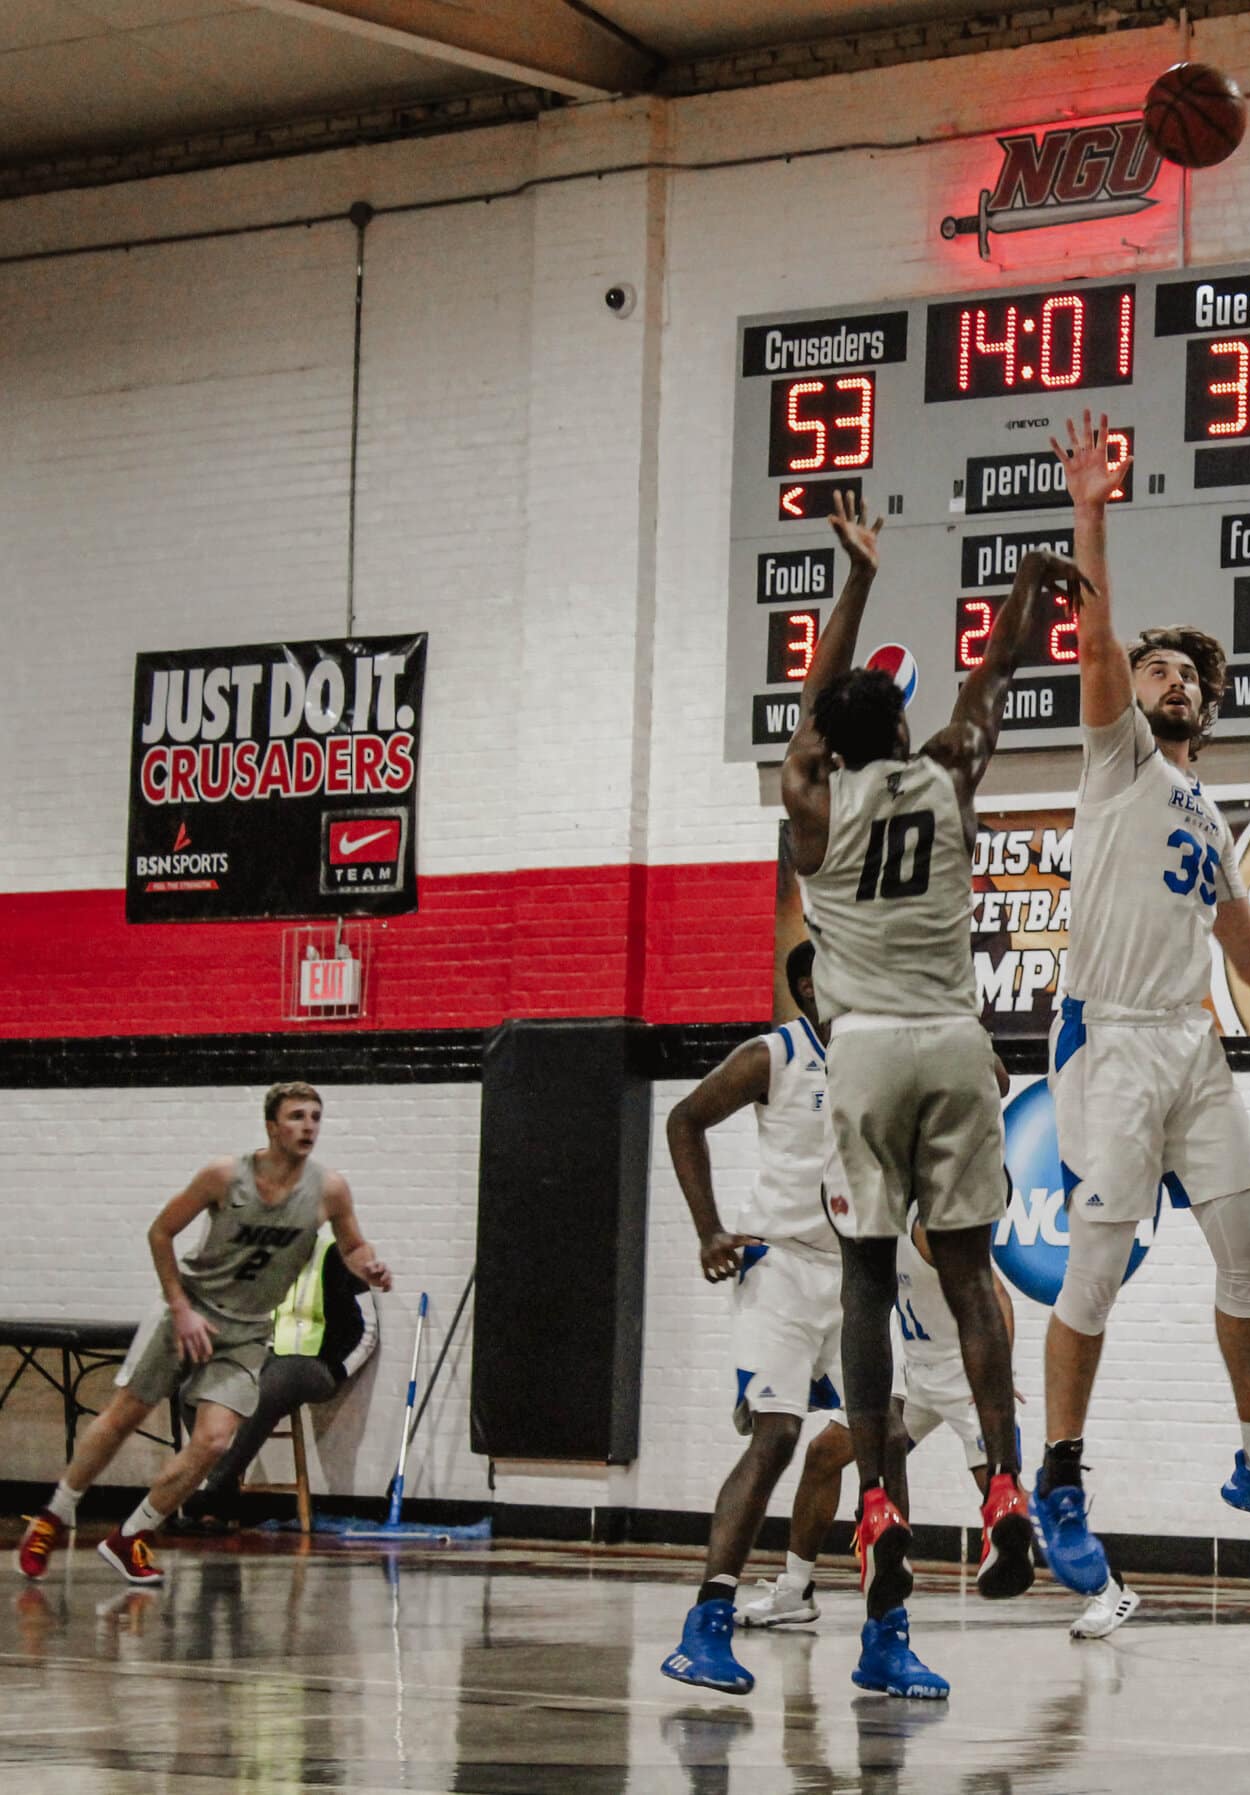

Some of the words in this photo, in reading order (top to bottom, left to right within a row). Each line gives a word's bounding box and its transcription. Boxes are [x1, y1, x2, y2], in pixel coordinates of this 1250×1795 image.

[986, 120, 1162, 212] NGU
[764, 327, 885, 371] Crusaders
[956, 293, 1136, 391] 14:01
[786, 376, 872, 470] 53
[765, 556, 826, 597] fouls
[786, 614, 815, 679] 3
[960, 601, 991, 666] 2
[142, 663, 263, 744] JUST
[269, 658, 345, 737] DO
[353, 654, 415, 732] IT.
[765, 703, 801, 733] wo
[1002, 687, 1054, 720] ame
[141, 732, 415, 806] CRUSADERS
[335, 866, 392, 884] TEAM
[856, 811, 935, 902] 10
[971, 829, 1034, 876] 015
[309, 961, 346, 1000] EXIT
